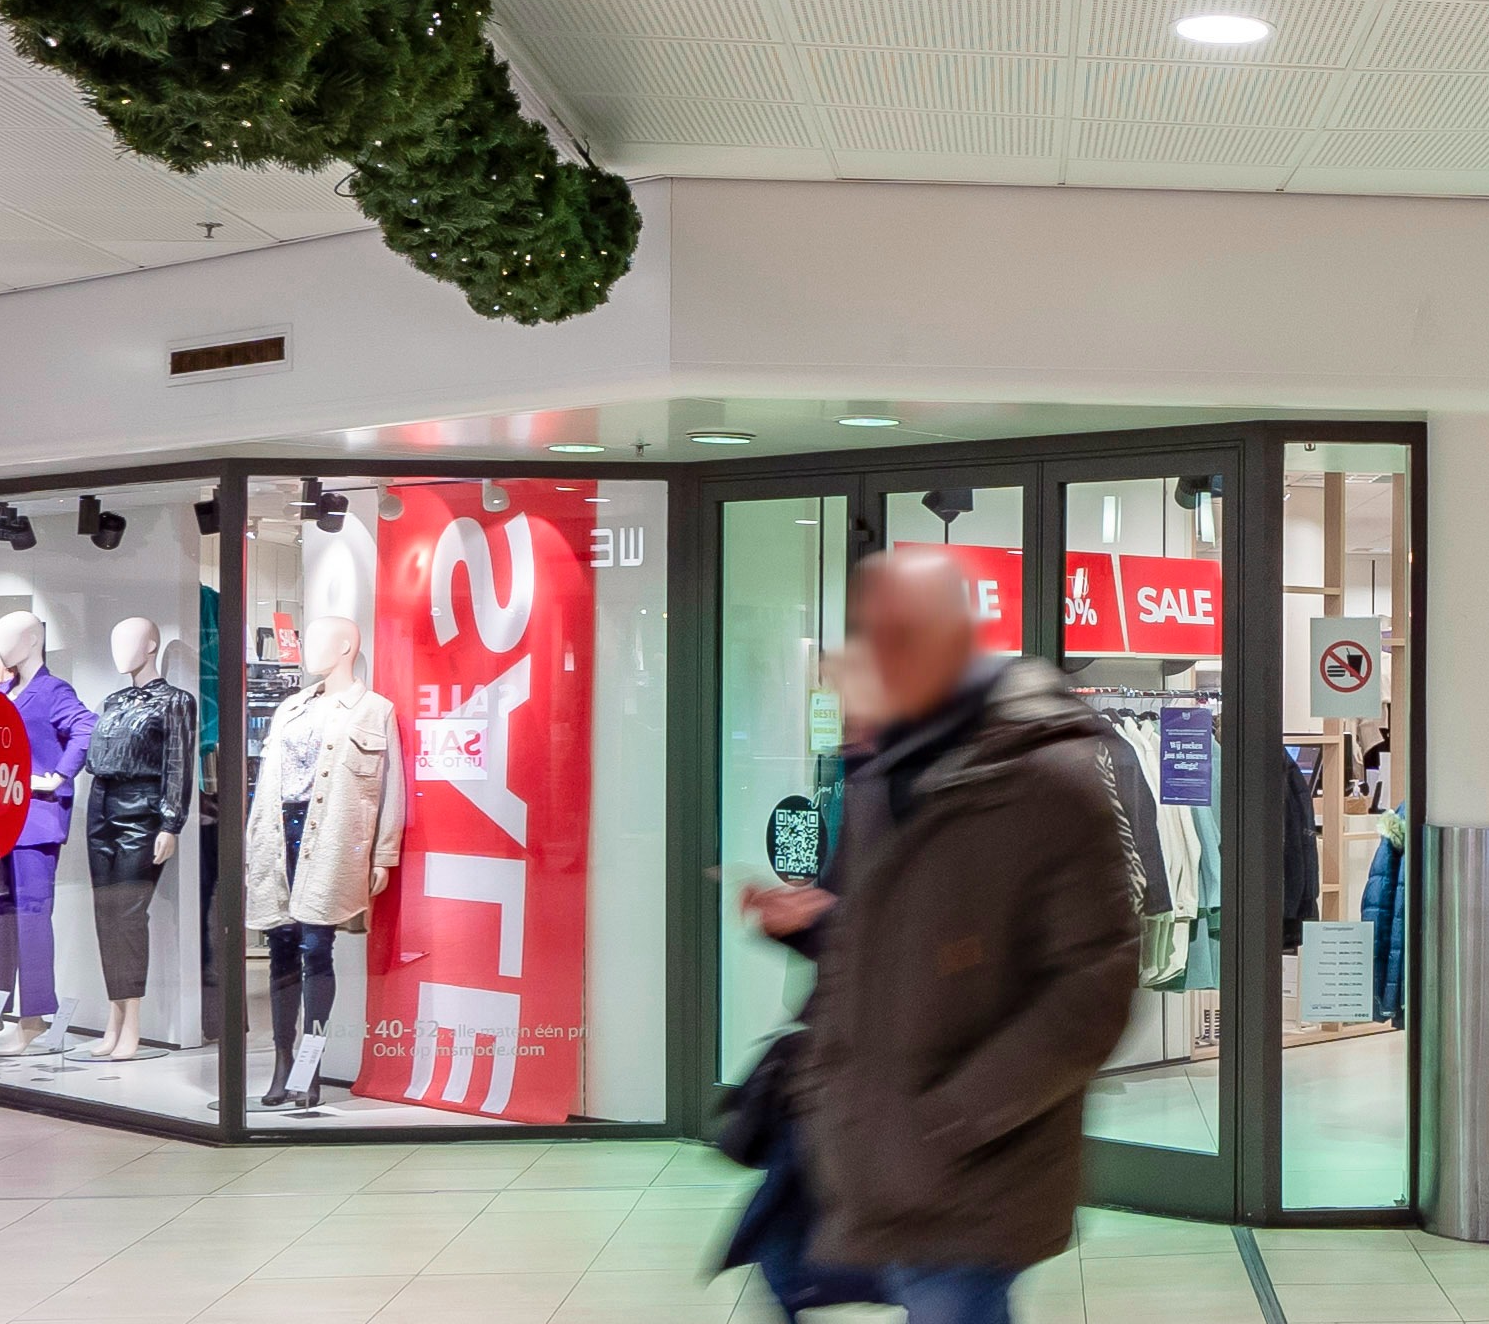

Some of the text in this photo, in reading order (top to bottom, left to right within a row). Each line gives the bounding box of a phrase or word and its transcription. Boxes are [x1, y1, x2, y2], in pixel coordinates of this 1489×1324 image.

[963, 580, 1001, 618] LE
[1065, 597, 1098, 626] 0%
[1137, 586, 1215, 626] SALE
[535, 1023, 564, 1039] één
[373, 1042, 407, 1058] Ook
[436, 1042, 546, 1058] msmode.com
